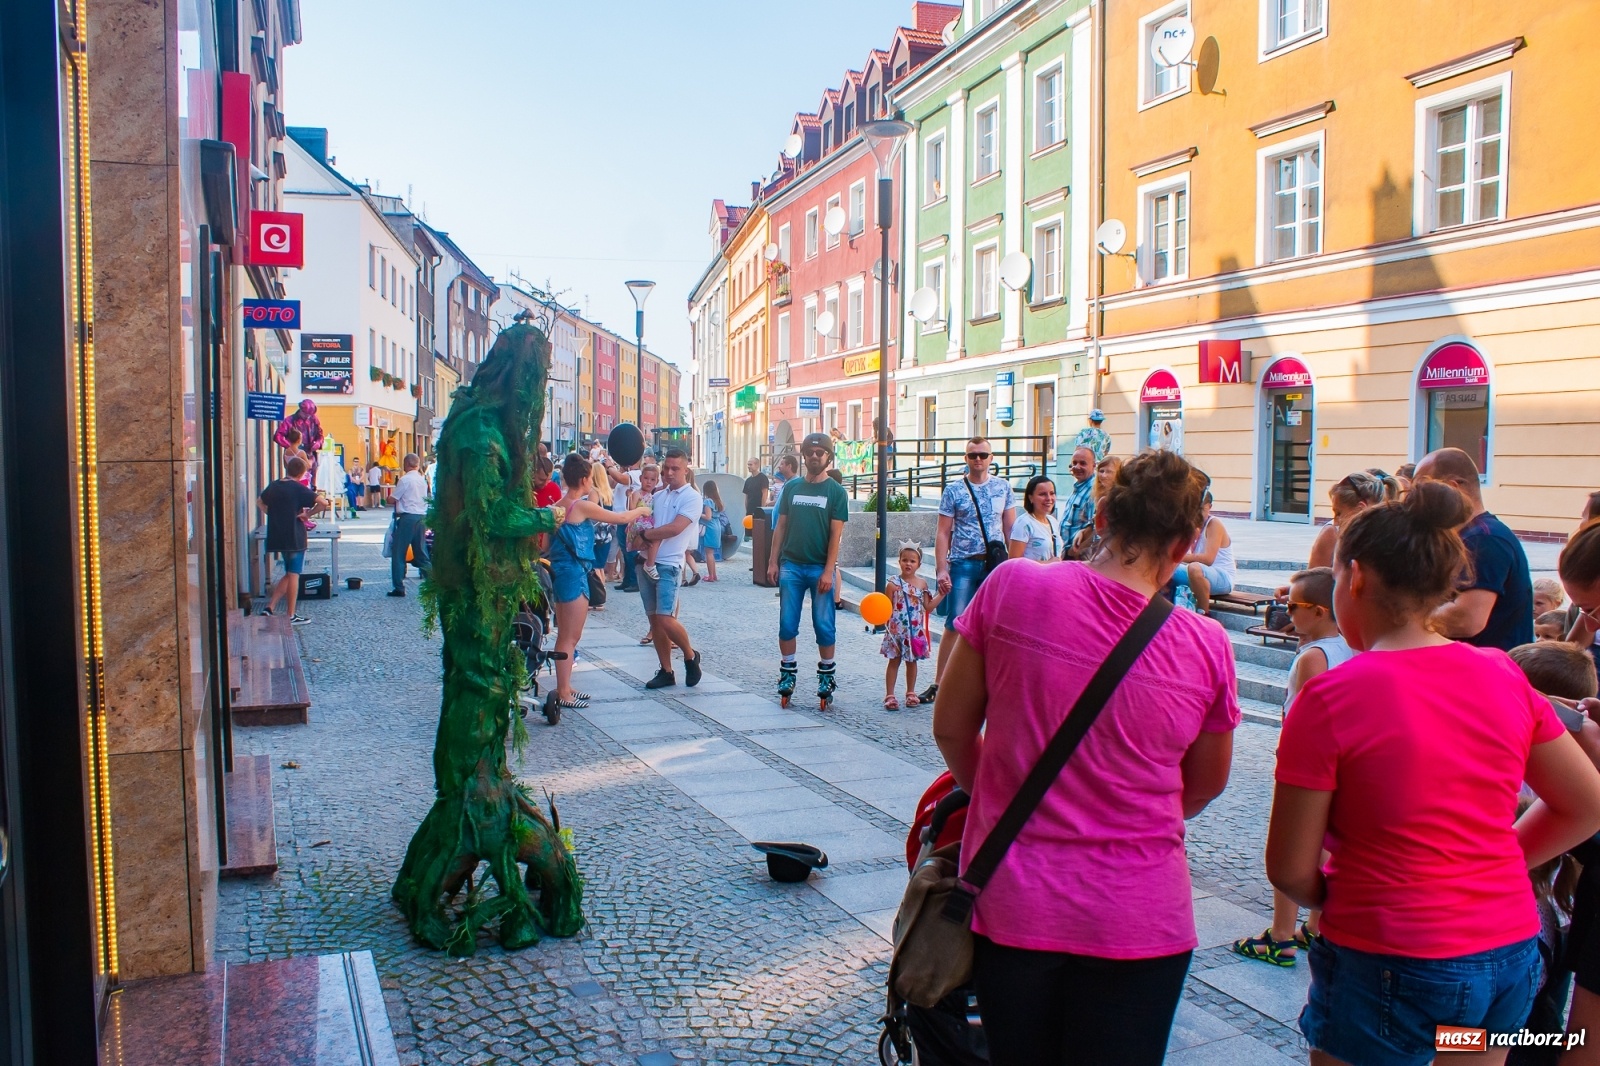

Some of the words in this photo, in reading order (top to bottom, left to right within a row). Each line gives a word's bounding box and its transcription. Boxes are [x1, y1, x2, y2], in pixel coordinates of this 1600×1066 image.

[1164, 29, 1186, 39] nc+
[243, 306, 295, 322] FOTO
[323, 357, 351, 365] JUBILER
[845, 357, 866, 374] OPTYK
[303, 370, 351, 378] PERFUMERIA
[1217, 356, 1241, 383] M
[1426, 366, 1485, 379] Millennium
[1270, 371, 1309, 382] Millennium
[1145, 386, 1180, 396] Millennium
